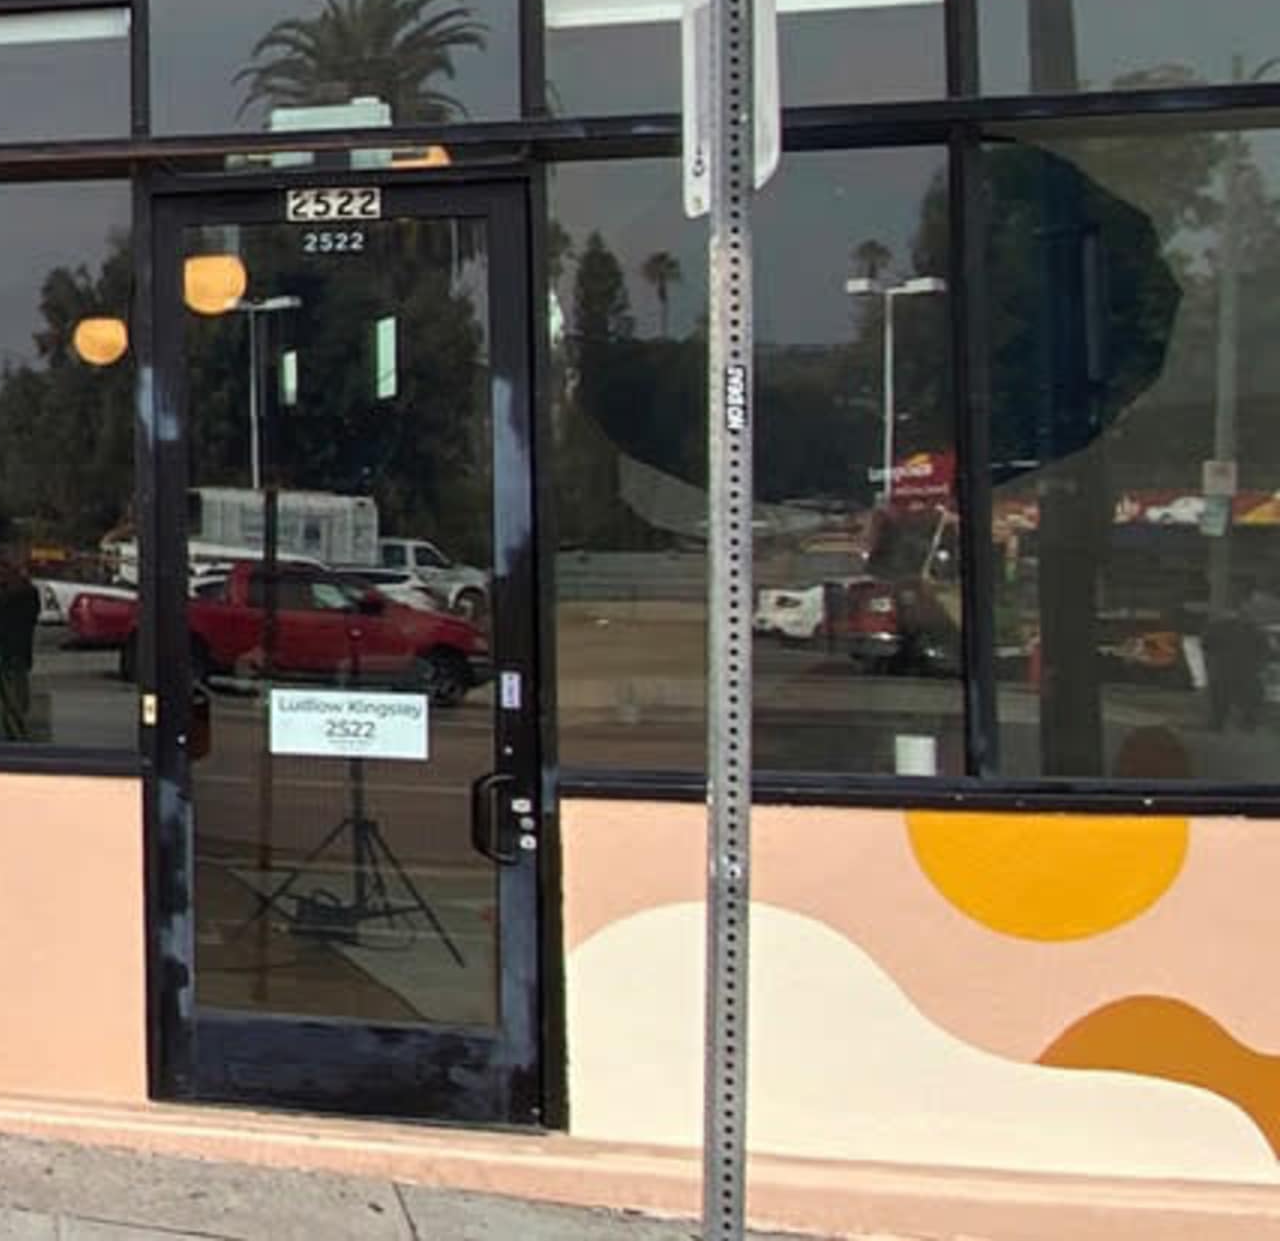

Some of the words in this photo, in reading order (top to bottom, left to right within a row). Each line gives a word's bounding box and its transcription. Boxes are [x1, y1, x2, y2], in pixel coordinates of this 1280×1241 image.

[291, 190, 378, 217] 2522
[303, 231, 365, 253] 2522
[277, 696, 343, 714] Ludlow
[325, 719, 376, 739] 2522
